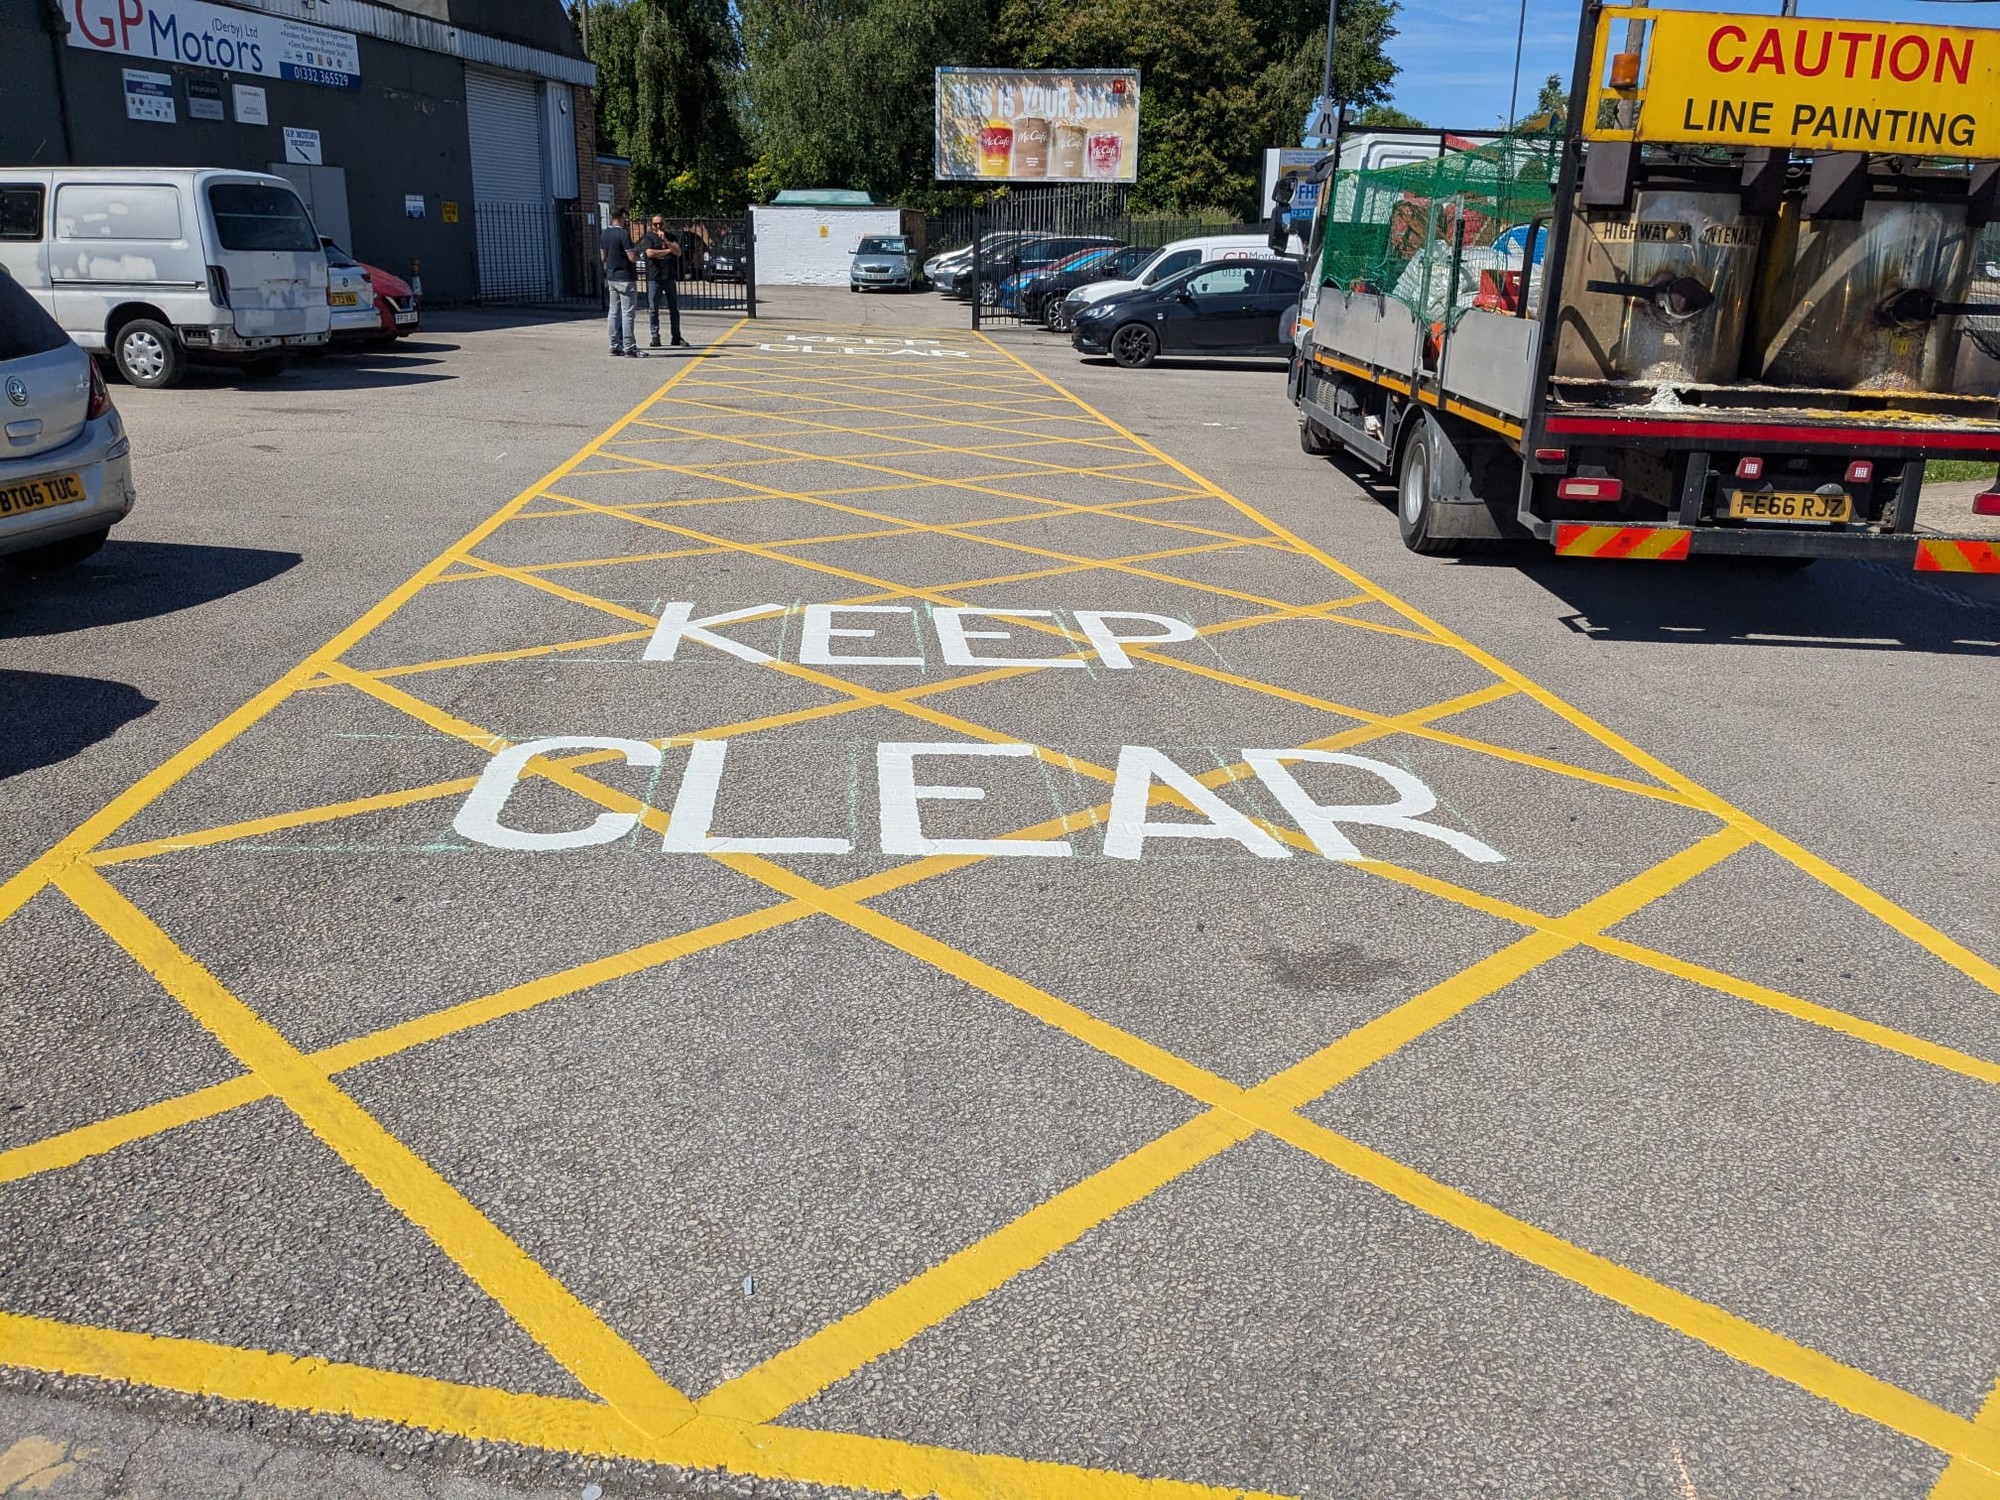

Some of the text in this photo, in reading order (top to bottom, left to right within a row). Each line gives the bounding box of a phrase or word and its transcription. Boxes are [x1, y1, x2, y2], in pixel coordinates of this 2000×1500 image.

[75, 0, 263, 72] GP Motors
[211, 17, 259, 38] (Derby) Ltd
[1707, 24, 1975, 84] CAUTION
[293, 66, 348, 86] 01332 365529
[998, 85, 1016, 118] IS
[1020, 85, 1070, 117] YOUR
[1075, 85, 1119, 119] SIGN
[296, 131, 318, 140] MOTORS
[1683, 98, 1977, 147] LINE PAINTING
[1604, 221, 1671, 241] HIGHWAY
[0, 476, 79, 512] BT05 TUC
[1739, 494, 1844, 518] FE66 RJZ
[642, 601, 1197, 670] KEEP
[452, 735, 1507, 862] CLEAR
